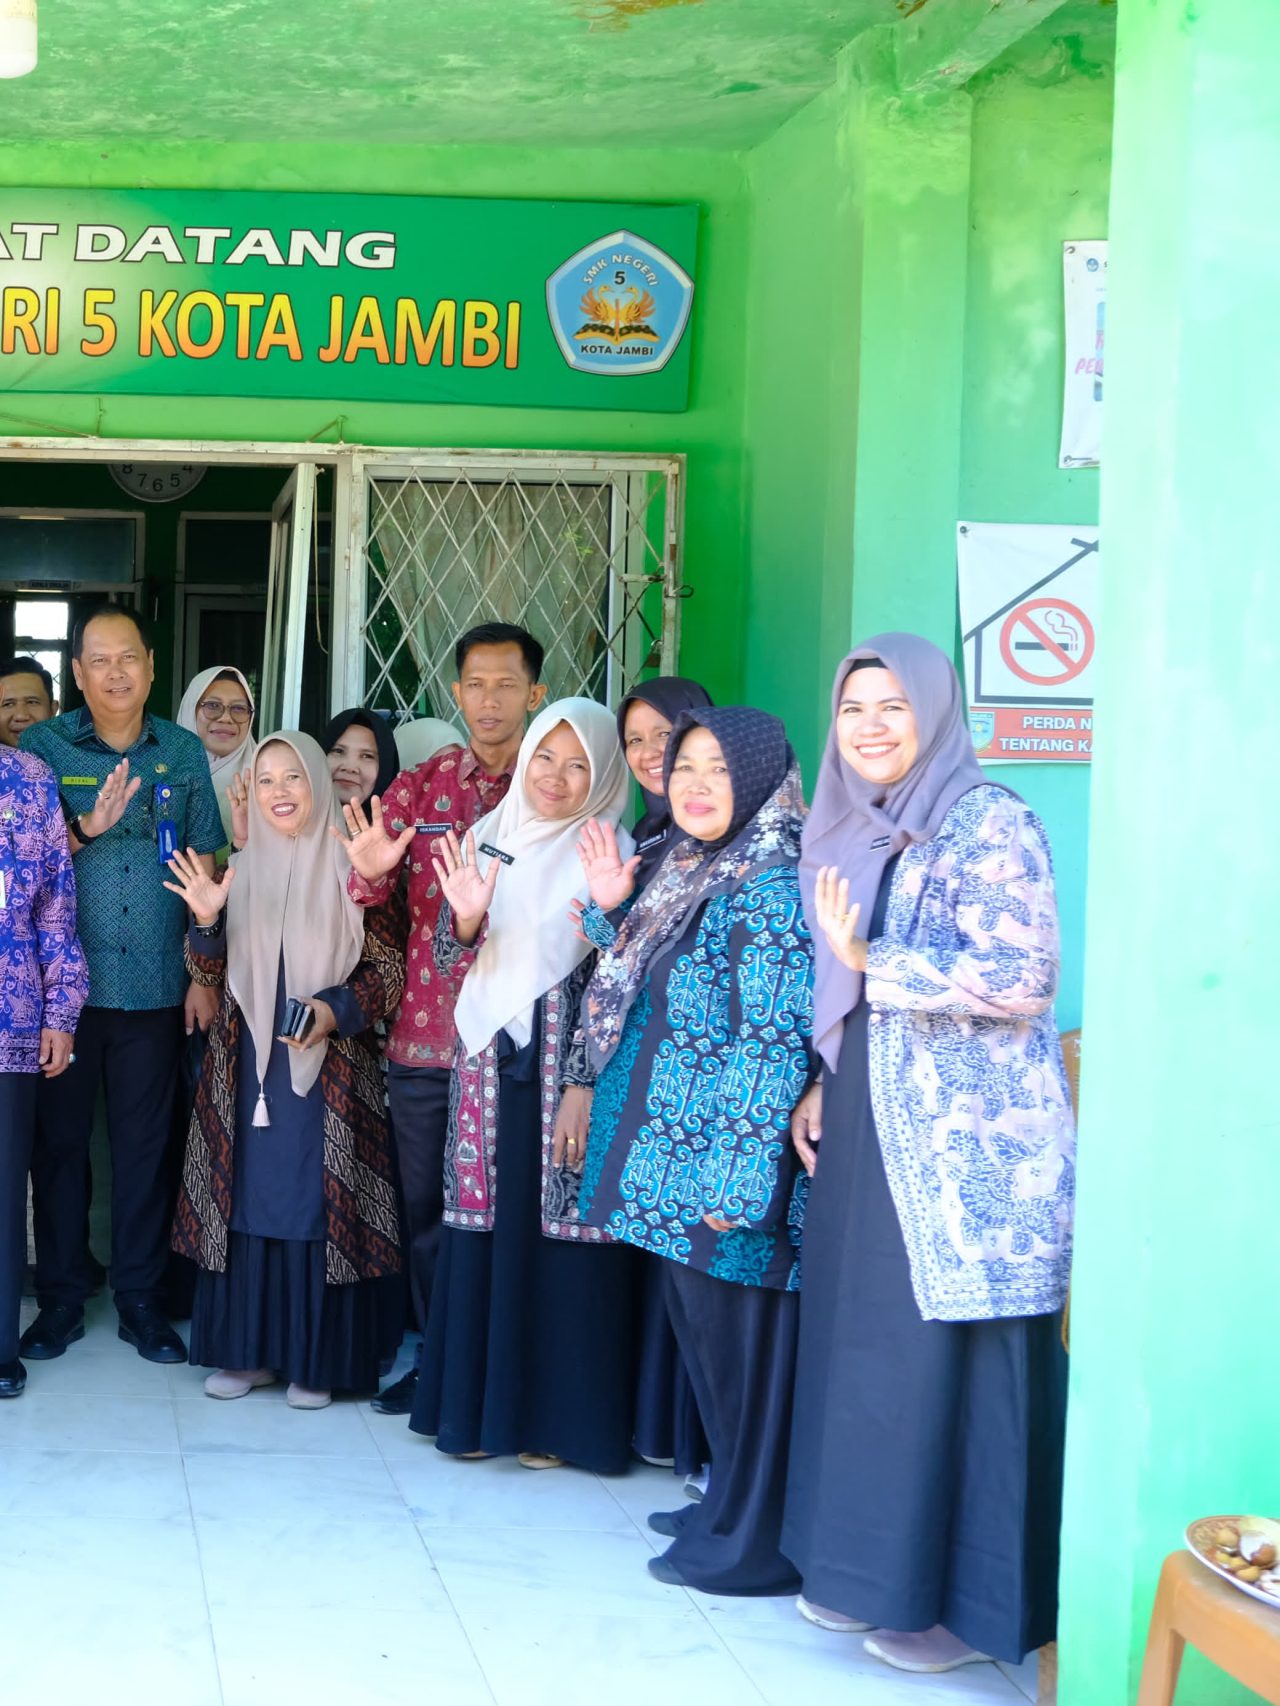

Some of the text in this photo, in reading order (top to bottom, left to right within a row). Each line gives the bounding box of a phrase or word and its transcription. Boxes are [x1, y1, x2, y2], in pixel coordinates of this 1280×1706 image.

[73, 223, 397, 270] DATANG
[583, 254, 659, 286] SMK NEGERI
[614, 271, 626, 285] 5
[80, 288, 118, 357] 5
[138, 289, 304, 362] KOTA
[318, 295, 521, 369] JAMBI
[581, 345, 654, 355] KOTA JAMBI
[138, 473, 147, 487] 7
[152, 478, 163, 492] 6
[170, 474, 180, 487] 5
[1023, 715, 1076, 730] PERDA
[999, 737, 1074, 752] TENTANG
